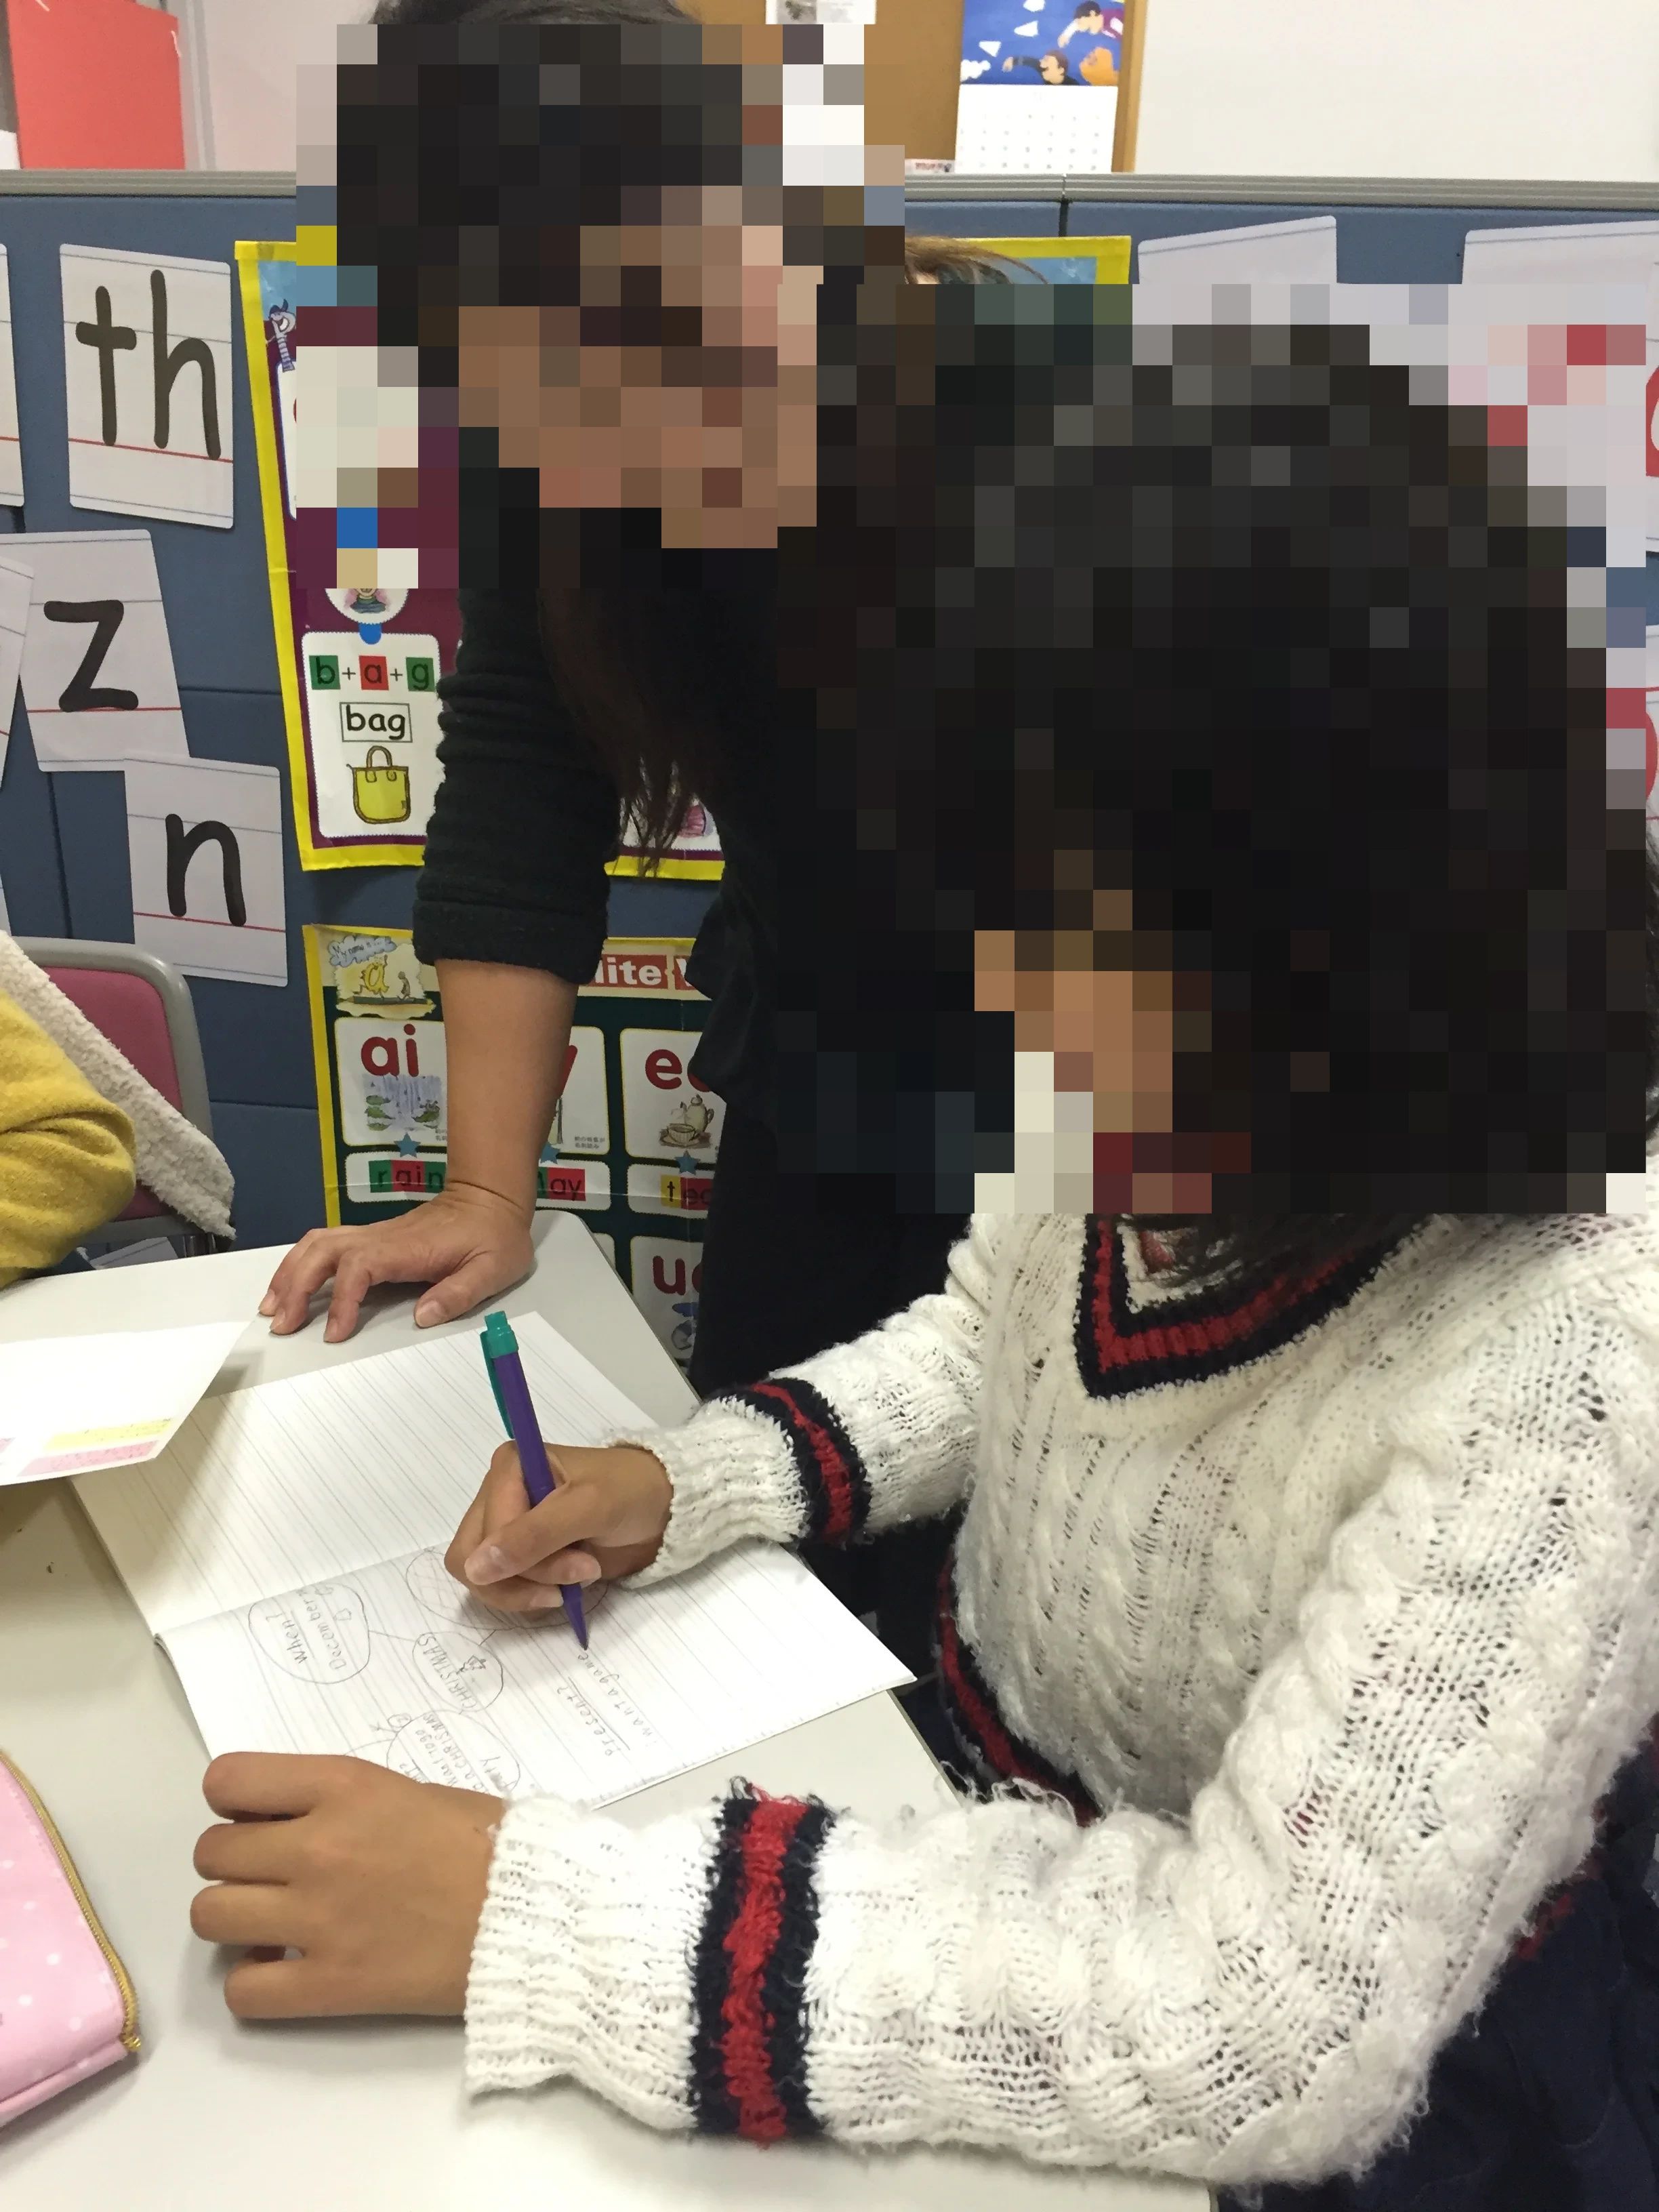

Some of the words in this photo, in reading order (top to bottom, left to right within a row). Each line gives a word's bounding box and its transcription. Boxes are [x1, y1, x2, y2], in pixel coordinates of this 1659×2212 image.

[75, 270, 222, 461] th
[346, 704, 405, 740] bag
[165, 813, 247, 926] n
[361, 1023, 419, 1077] ai
[377, 1166, 444, 1189] rain
[538, 1171, 582, 1201] ay
